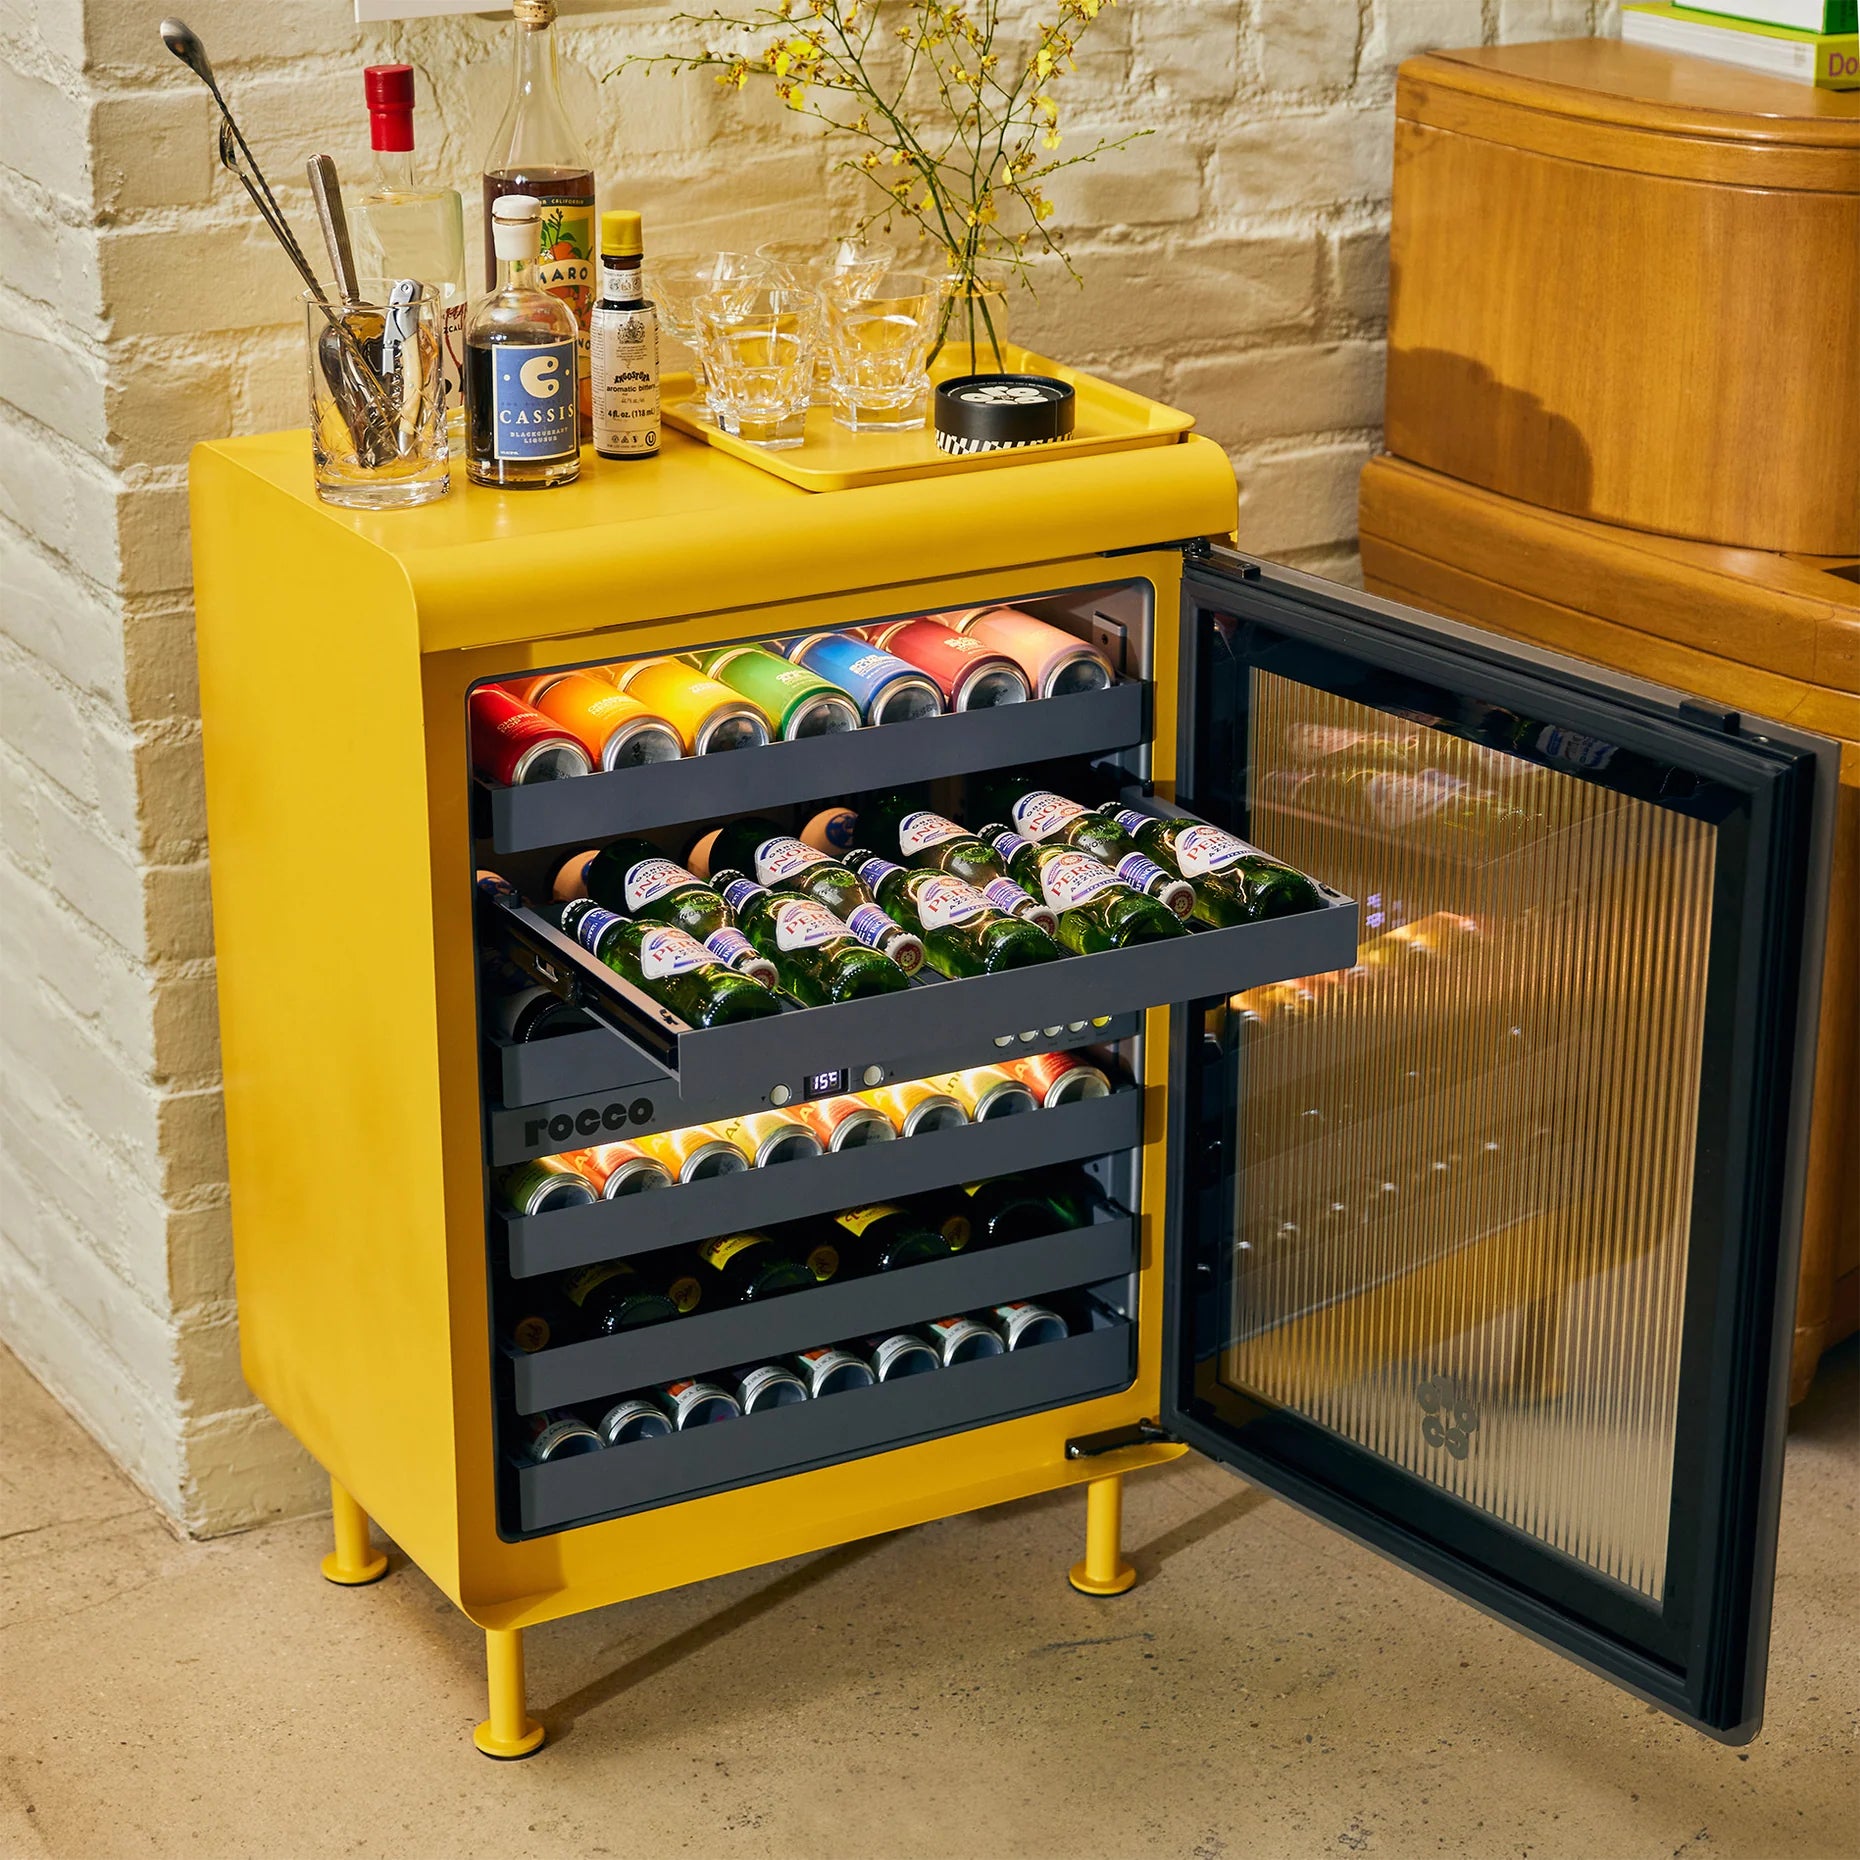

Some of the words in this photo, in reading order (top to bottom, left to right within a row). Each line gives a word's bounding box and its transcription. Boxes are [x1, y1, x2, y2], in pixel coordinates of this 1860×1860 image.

[614, 370, 651, 384] ANGOSTURA
[606, 384, 637, 393] aromatic
[638, 383, 656, 393] bitters
[499, 403, 574, 425] CASSIS
[607, 410, 613, 418] 4
[621, 411, 631, 419] oz.
[631, 409, 646, 418] (118
[496, 711, 539, 732] CHERRY
[1051, 863, 1111, 898] PERO
[525, 1097, 654, 1148] rocco
